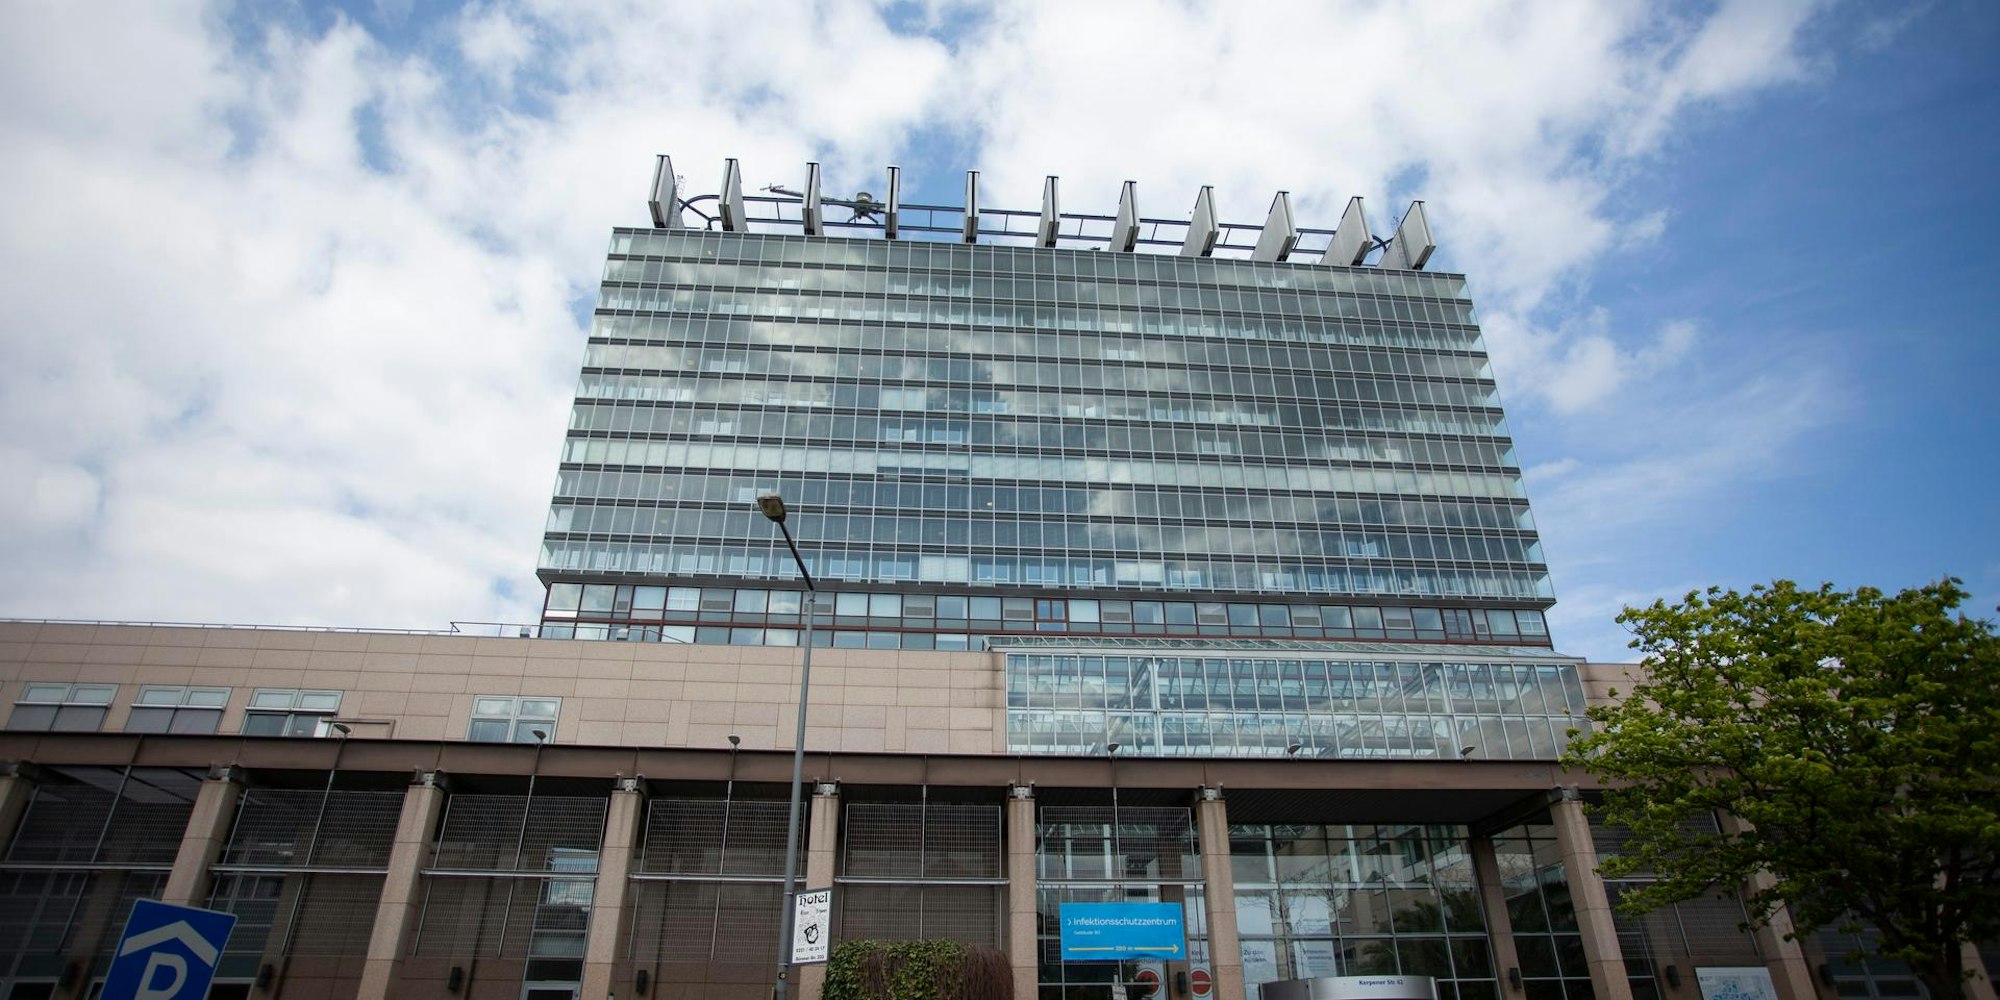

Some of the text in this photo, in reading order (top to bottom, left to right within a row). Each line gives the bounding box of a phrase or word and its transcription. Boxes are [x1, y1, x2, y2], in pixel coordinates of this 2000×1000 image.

[1073, 917, 1177, 926] Infektionsschutzzentrum
[134, 951, 188, 1000] P
[1358, 979, 1386, 987] Kerpener
